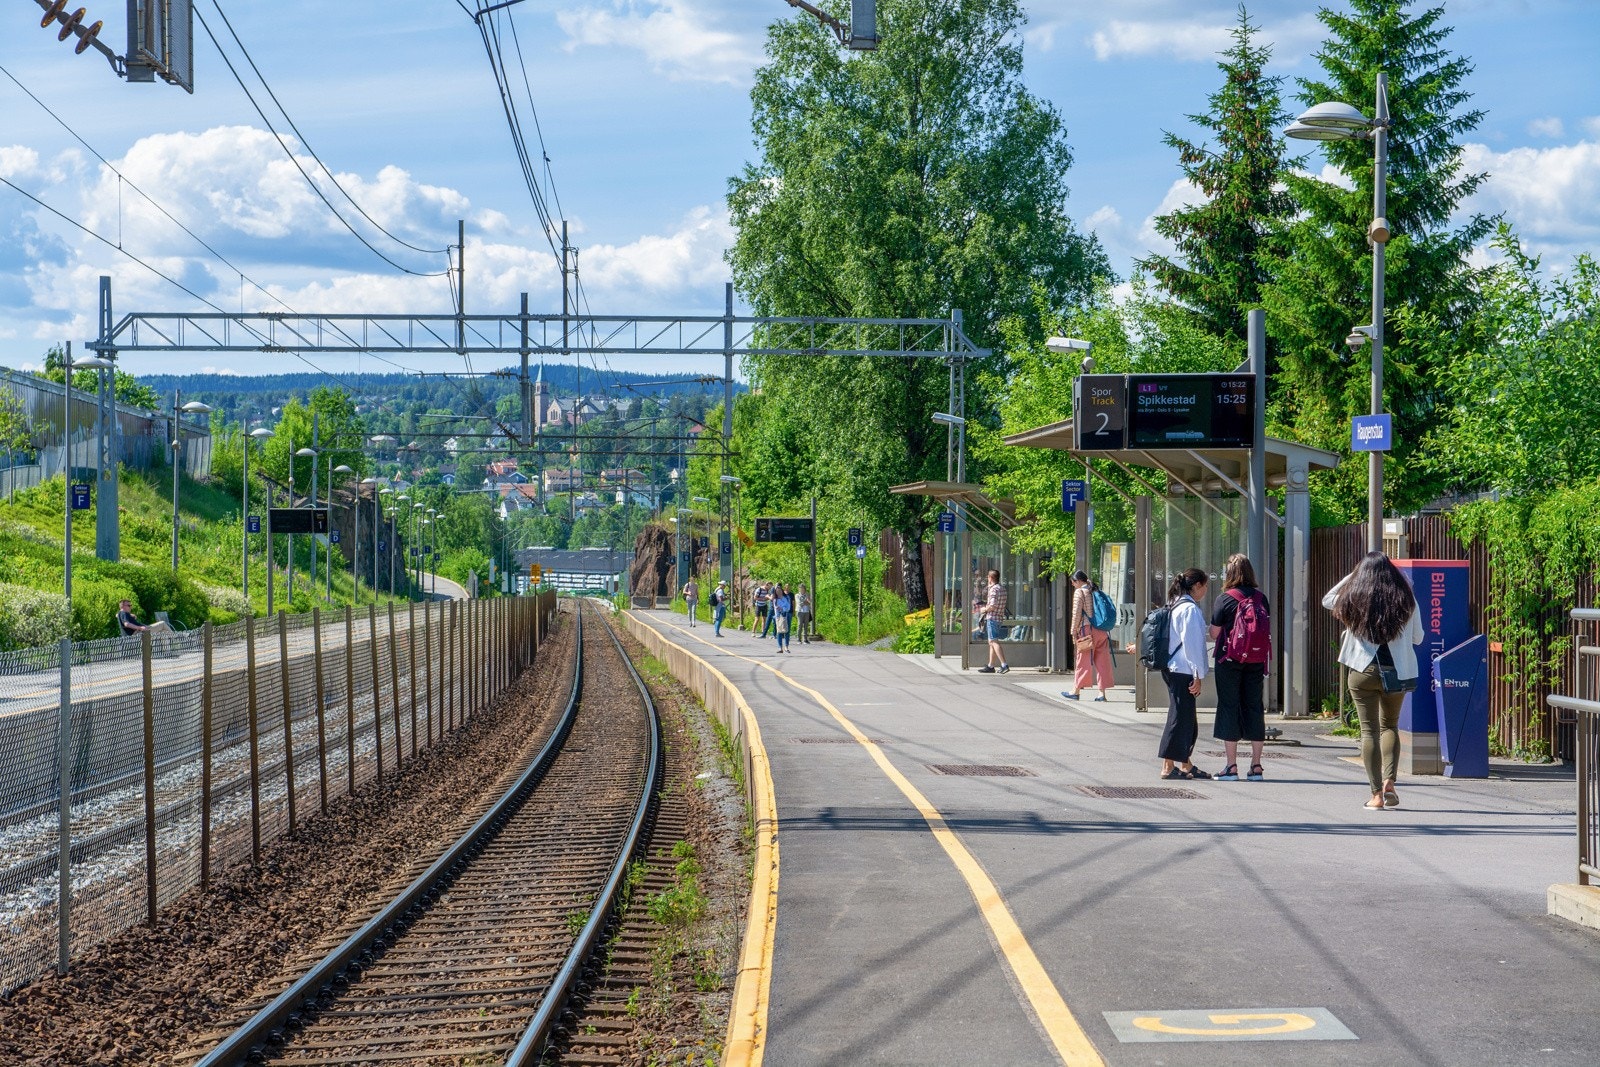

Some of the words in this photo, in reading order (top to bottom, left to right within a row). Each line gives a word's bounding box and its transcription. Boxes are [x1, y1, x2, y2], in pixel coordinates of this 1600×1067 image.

[1091, 387, 1112, 398] Spor
[1091, 396, 1115, 405] Track
[1138, 394, 1196, 407] Spikkestad
[1216, 394, 1246, 404] 15:25
[1095, 412, 1110, 436] 2
[78, 495, 85, 506] F
[1070, 493, 1078, 507] F
[251, 522, 257, 531] E
[943, 522, 950, 532] E
[760, 529, 766, 539] 2
[851, 535, 858, 543] D
[1430, 572, 1446, 635] Billetter
